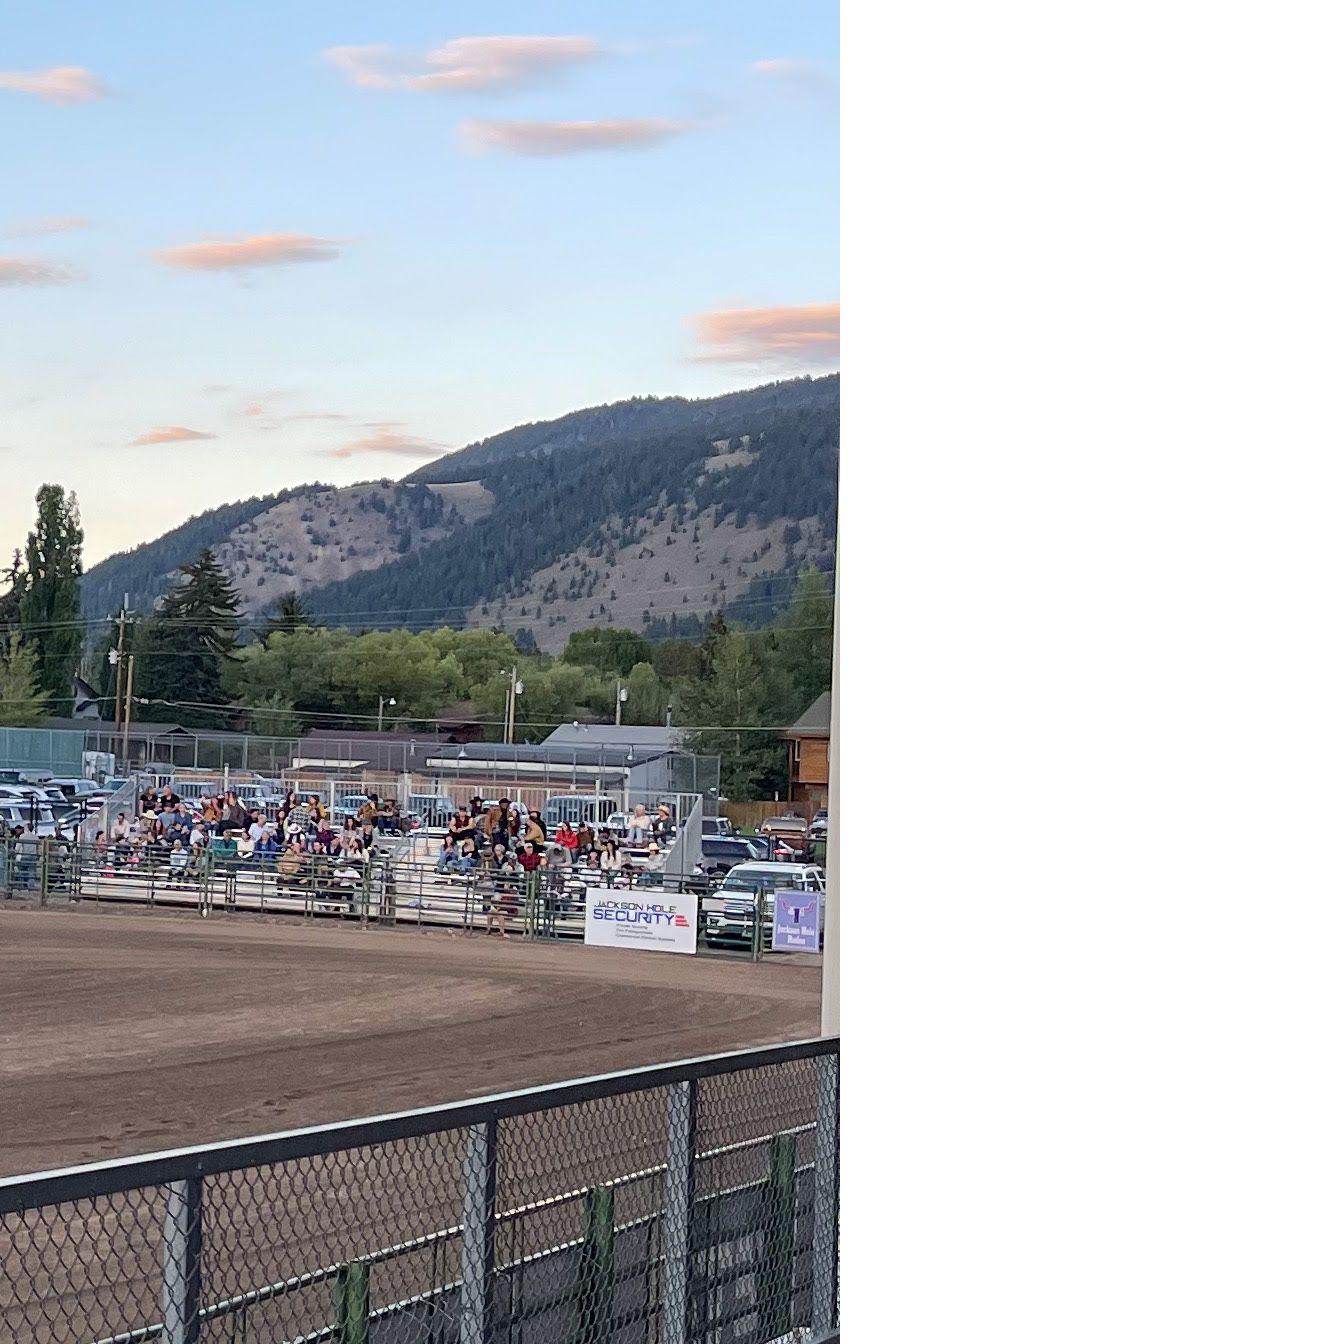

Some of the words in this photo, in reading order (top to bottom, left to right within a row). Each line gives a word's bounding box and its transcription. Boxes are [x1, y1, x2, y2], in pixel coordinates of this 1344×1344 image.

[594, 900, 644, 911] JACKSON
[646, 903, 676, 914] HOLE
[593, 909, 675, 926] SECURITY
